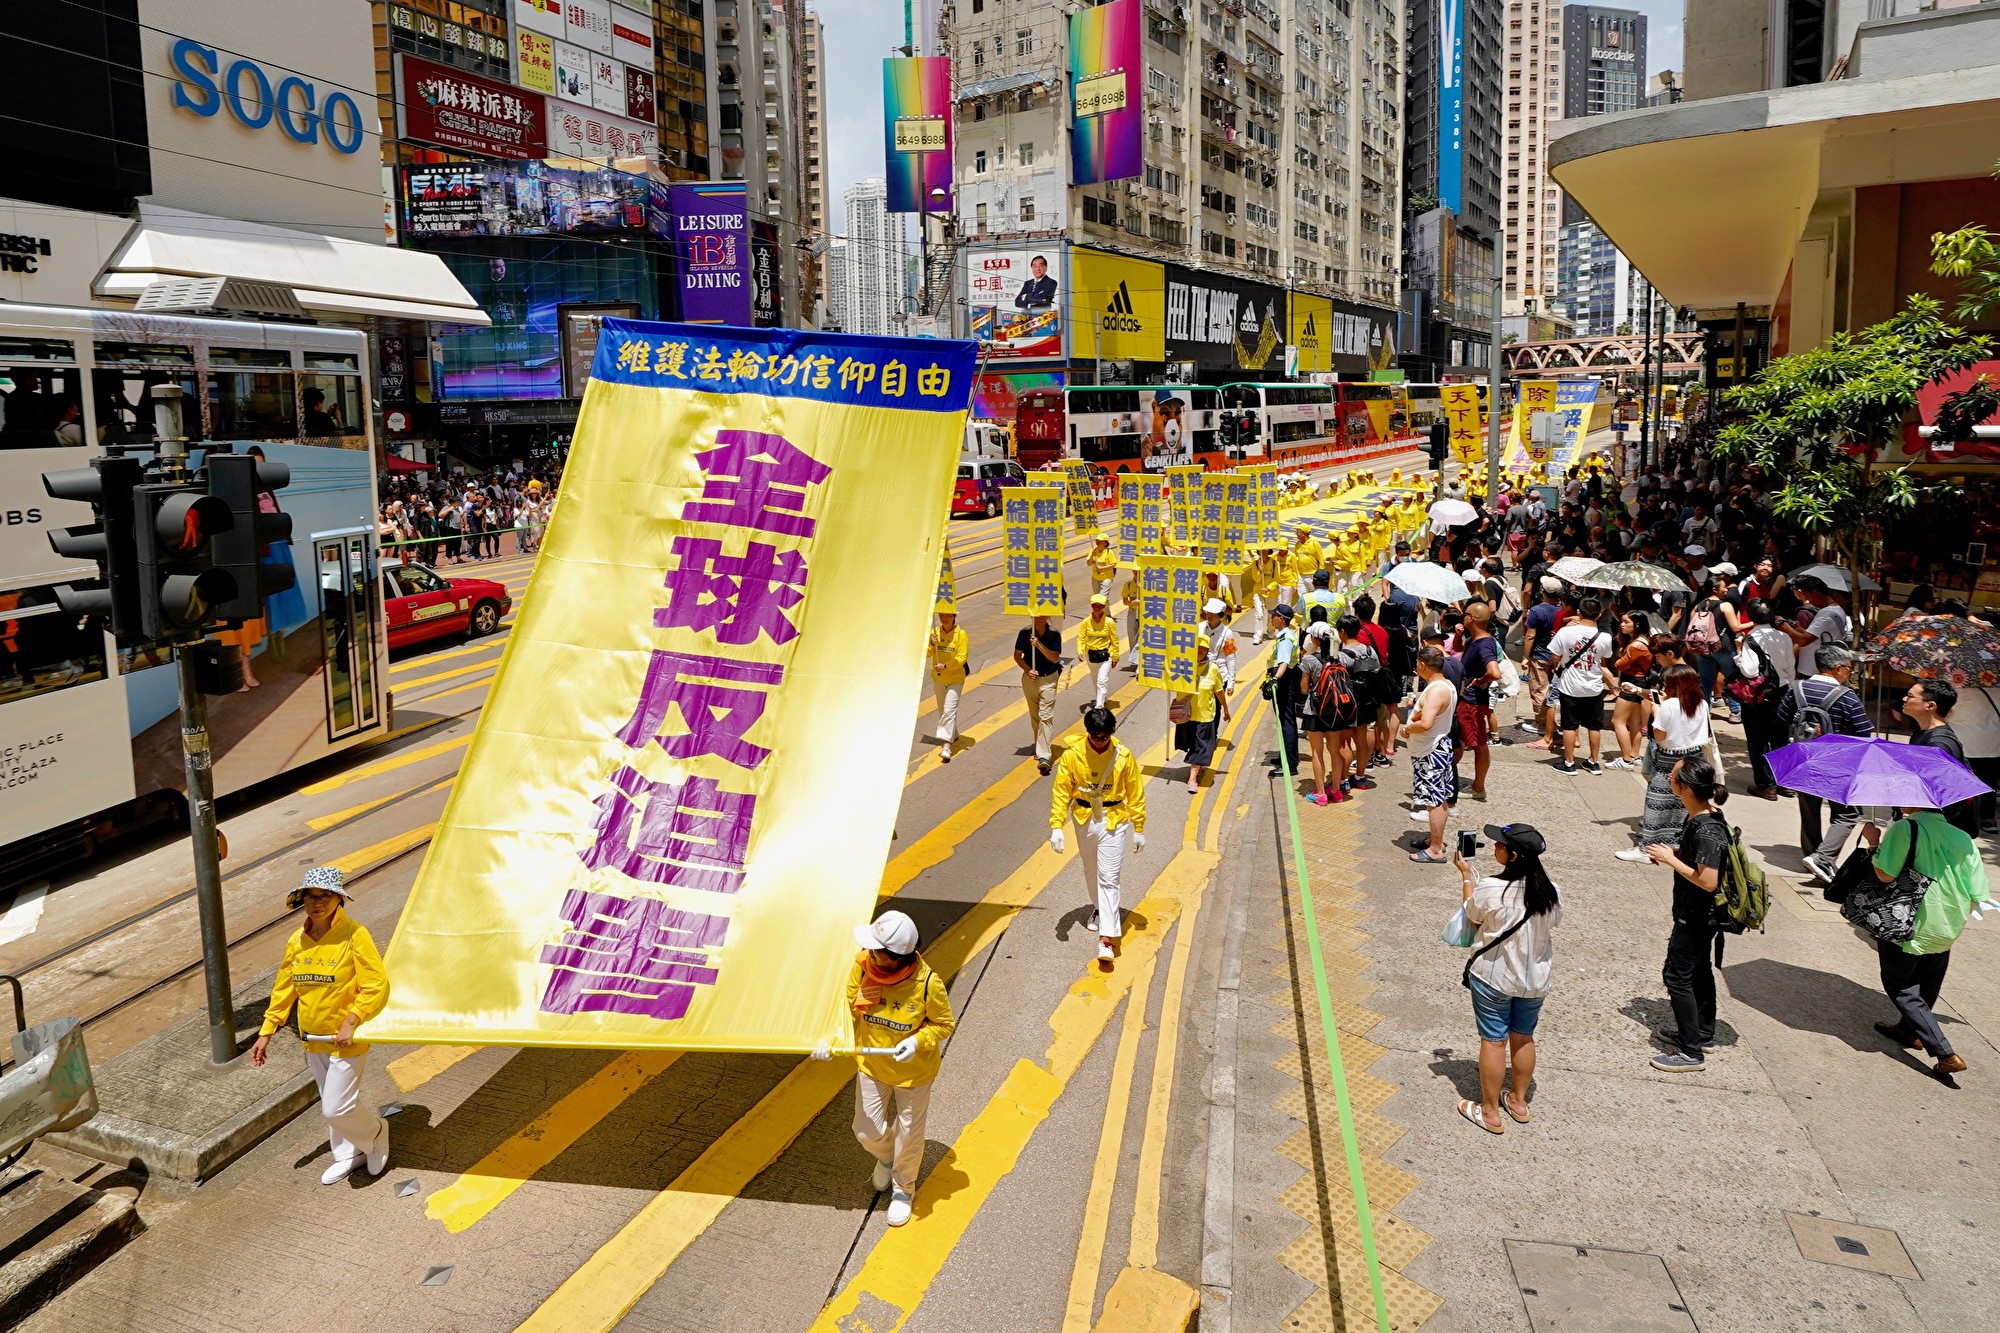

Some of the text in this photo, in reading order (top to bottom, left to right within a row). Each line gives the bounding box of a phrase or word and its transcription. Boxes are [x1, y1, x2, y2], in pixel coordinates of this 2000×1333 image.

[520, 33, 551, 55] 傷心
[1591, 46, 1635, 62] Rosedale
[520, 51, 552, 71] 酸辣粉
[171, 38, 364, 155] SOGO
[437, 79, 522, 124] 麻辣派對
[1076, 90, 1126, 111] 5649 6988
[896, 135, 945, 146] 5649 6988
[411, 173, 485, 196] EMF
[413, 213, 439, 222] e-Sports
[439, 213, 477, 222] tournaments
[680, 213, 744, 231] LEISURE
[686, 272, 741, 289] DINING
[757, 246, 772, 309] 金百利
[974, 276, 1003, 291] 中風
[1102, 312, 1140, 333] adidas
[1166, 281, 1190, 342] FEEL
[1190, 285, 1210, 343] THE
[1239, 320, 1260, 333] adidas
[1332, 311, 1345, 355] FEEL
[1300, 337, 1319, 349] adidas
[614, 338, 953, 398] 維護法輪功信仰自由
[1030, 422, 1048, 438] 90
[1448, 390, 1477, 459] 天下太平
[1144, 454, 1191, 469] GENKI LIFE
[1074, 465, 1099, 530] 解體中共
[1170, 473, 1188, 541] 結束迫害
[1259, 471, 1278, 544] 解體中共
[0, 508, 43, 526] BS
[1119, 482, 1139, 563] 結束迫害
[1201, 482, 1224, 566] 結束迫害
[1223, 483, 1248, 567] 解體中共
[1005, 498, 1031, 607] 結束迫害
[1033, 498, 1059, 607] 解體中共
[1141, 566, 1169, 680] 結束迫害
[1170, 567, 1199, 685] 解體中共
[538, 428, 834, 1022] 全球反迫害
[18, 732, 64, 753] PLACE
[11, 756, 58, 777] PLAZA
[0, 771, 38, 791] .COM
[889, 1021, 911, 1032] DAFA
